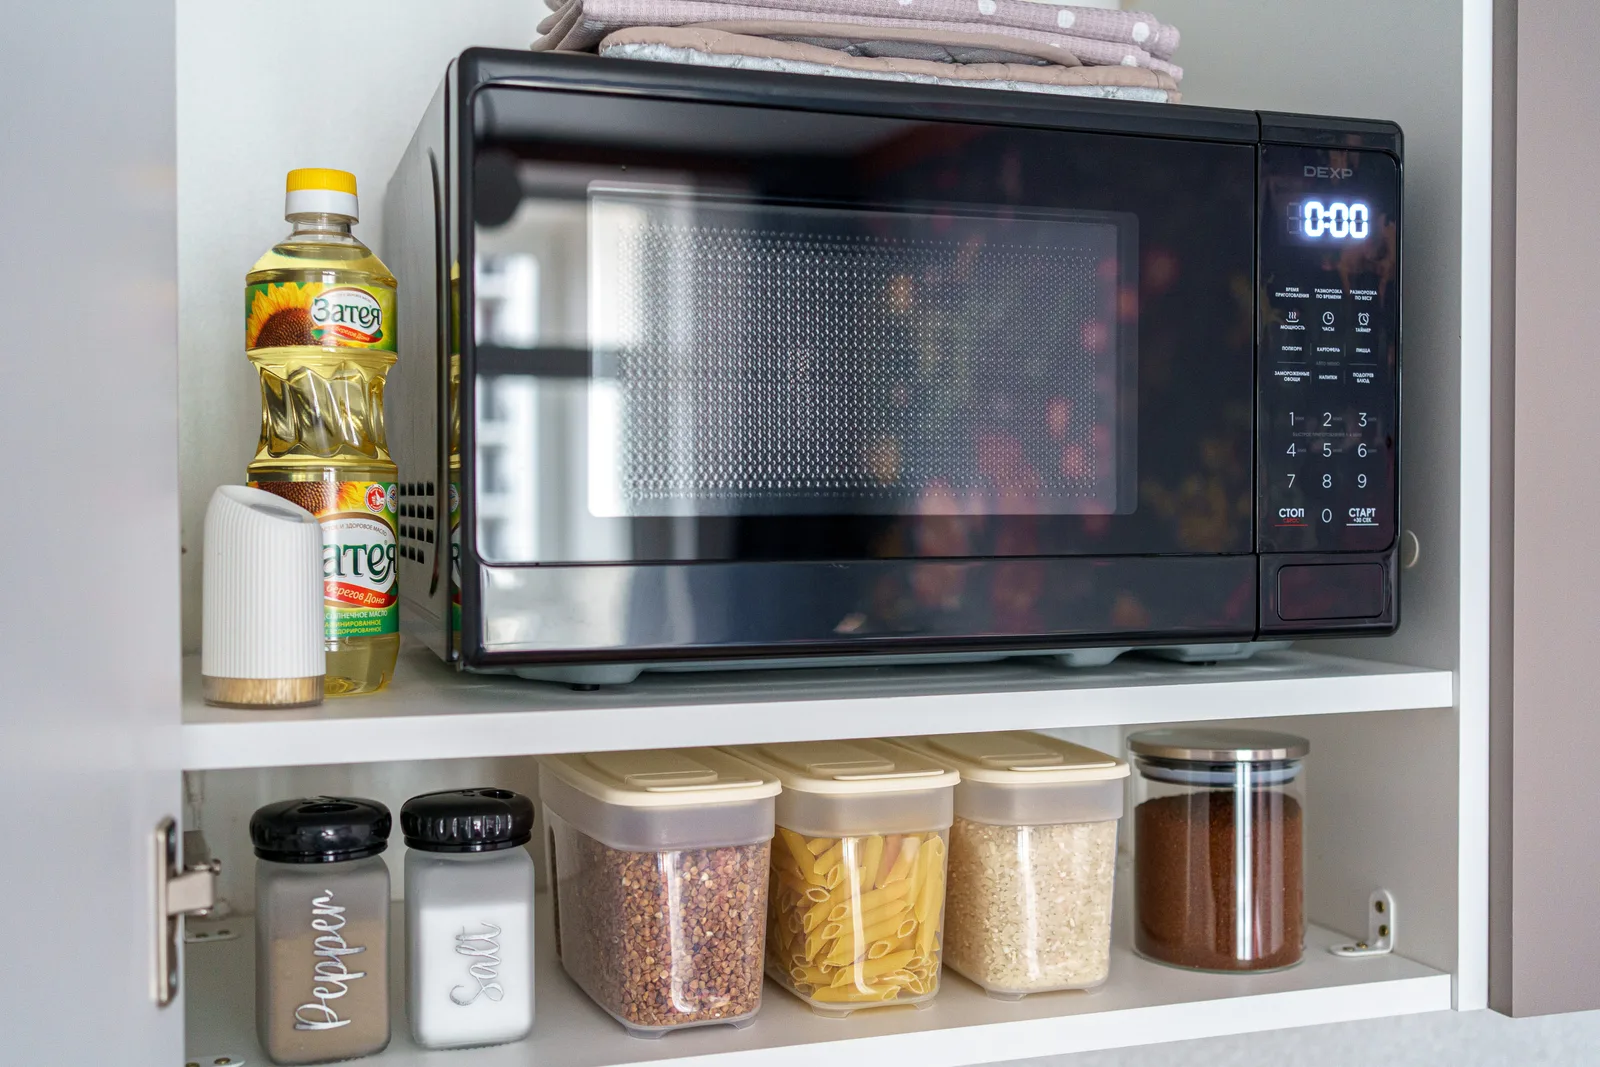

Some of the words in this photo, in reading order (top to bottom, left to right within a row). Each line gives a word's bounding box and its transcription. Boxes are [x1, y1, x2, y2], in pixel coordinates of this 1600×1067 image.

[1303, 165, 1353, 179] DEXP
[1304, 201, 1369, 239] 0:00
[313, 298, 382, 329] Затея
[1289, 411, 1294, 427] 1
[1323, 411, 1332, 427] 2
[1358, 412, 1368, 427] 3
[1286, 442, 1297, 457] 4
[1322, 442, 1332, 458] 5
[1357, 442, 1367, 458] 6
[1286, 473, 1296, 489] 7
[1322, 473, 1332, 489] 8
[1357, 473, 1367, 489] 9
[1278, 507, 1305, 518] СТОП
[1321, 508, 1332, 523] 0
[1348, 507, 1376, 518] СТАРТ
[345, 522, 373, 531] ЗДОРОВОЕ
[373, 525, 388, 537] МАСЛО
[322, 543, 397, 584] атея
[326, 583, 364, 601] берегов
[363, 592, 386, 605] Дона
[324, 611, 368, 620] СОЛНЕЧНОЕ
[368, 609, 388, 618] МАСЛО
[324, 619, 382, 628] АИНИРОВАННОЕ
[293, 889, 367, 1031] Pepper
[449, 921, 504, 1006] Salt
